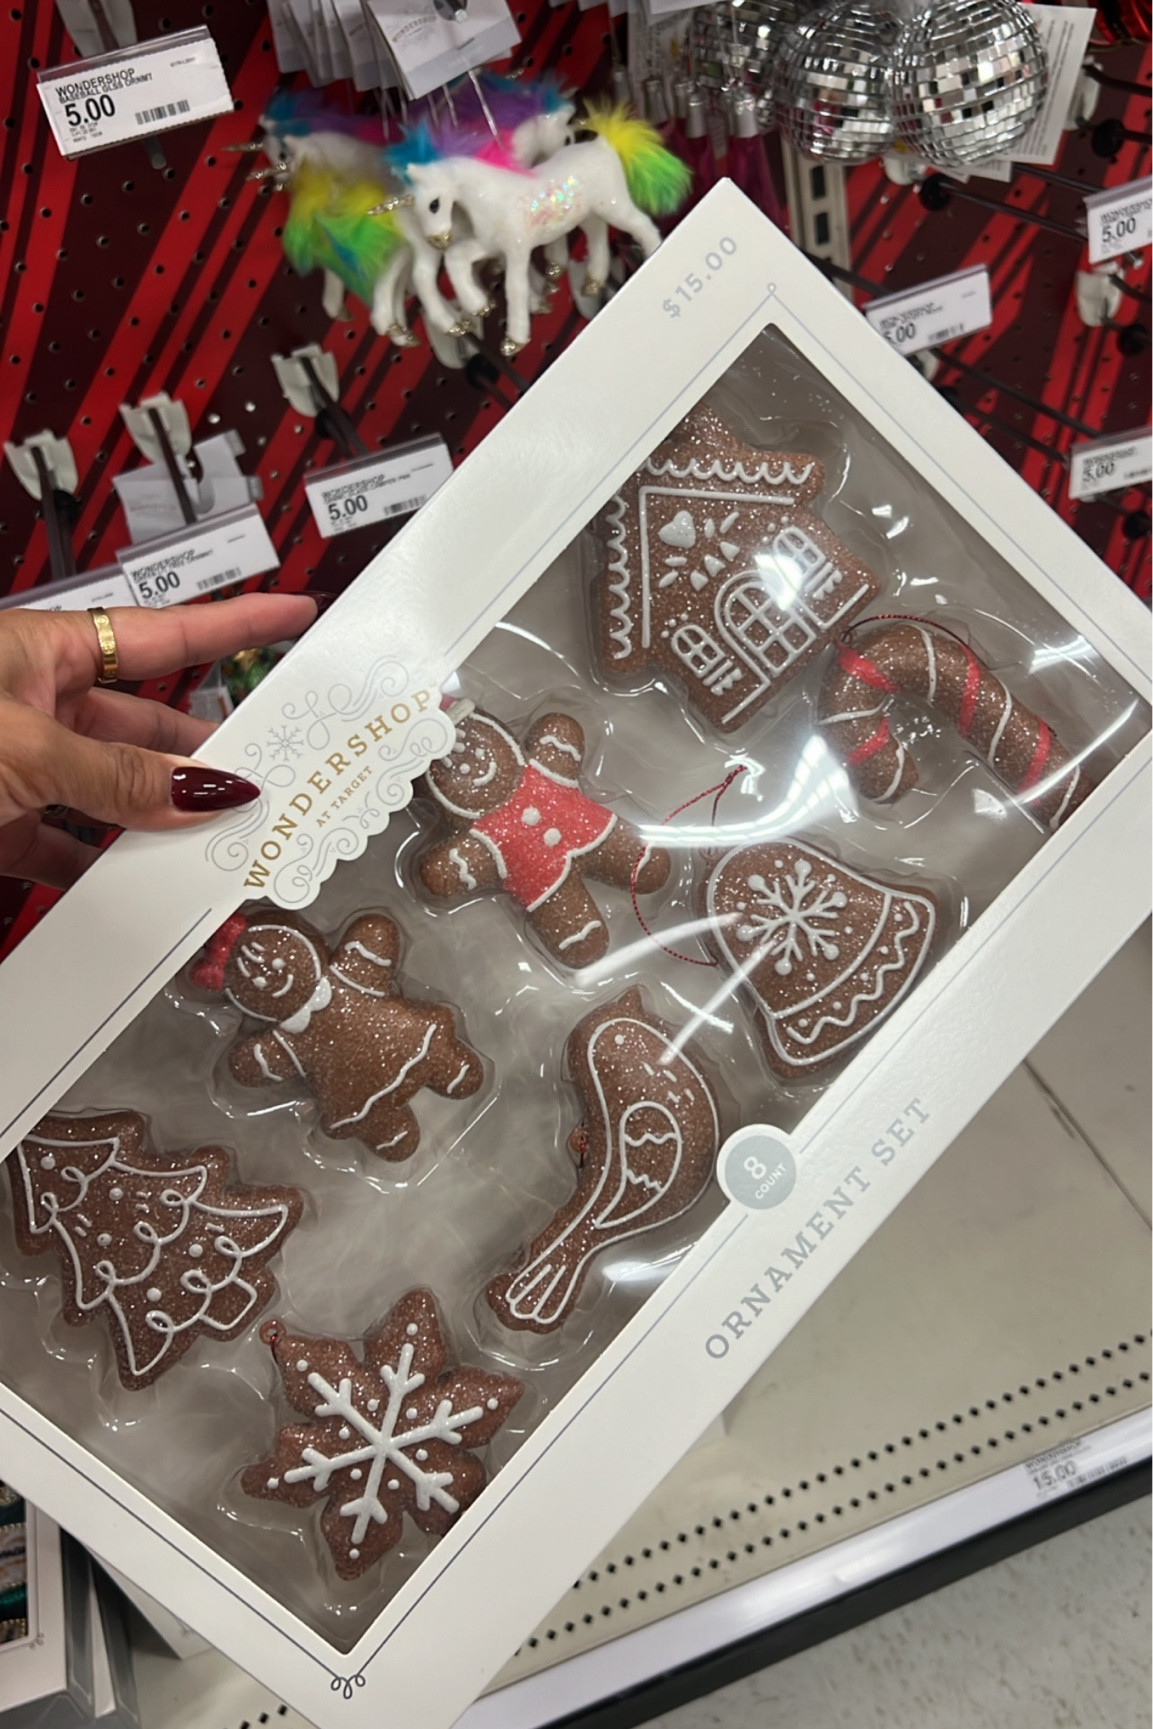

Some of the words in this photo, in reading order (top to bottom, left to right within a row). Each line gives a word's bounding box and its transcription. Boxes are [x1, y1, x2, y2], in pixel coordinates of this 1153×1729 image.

[55, 67, 135, 97] WONDERSHOP
[59, 86, 101, 103] BASEBALL
[65, 94, 116, 127] 5.00
[1102, 217, 1136, 243] 5.00
[662, 236, 737, 318] $15.00
[328, 495, 368, 521] 5.00
[139, 570, 181, 600] 5.00
[243, 689, 431, 889] WONDERSHOP
[315, 811, 332, 828] AT
[331, 765, 374, 810] TARGET
[743, 1155, 767, 1180] 8
[754, 1162, 787, 1200] COUNT
[705, 1166, 871, 1359] ORNAMENT
[871, 1097, 930, 1167] SET
[1033, 1460, 1078, 1490] 15.00
